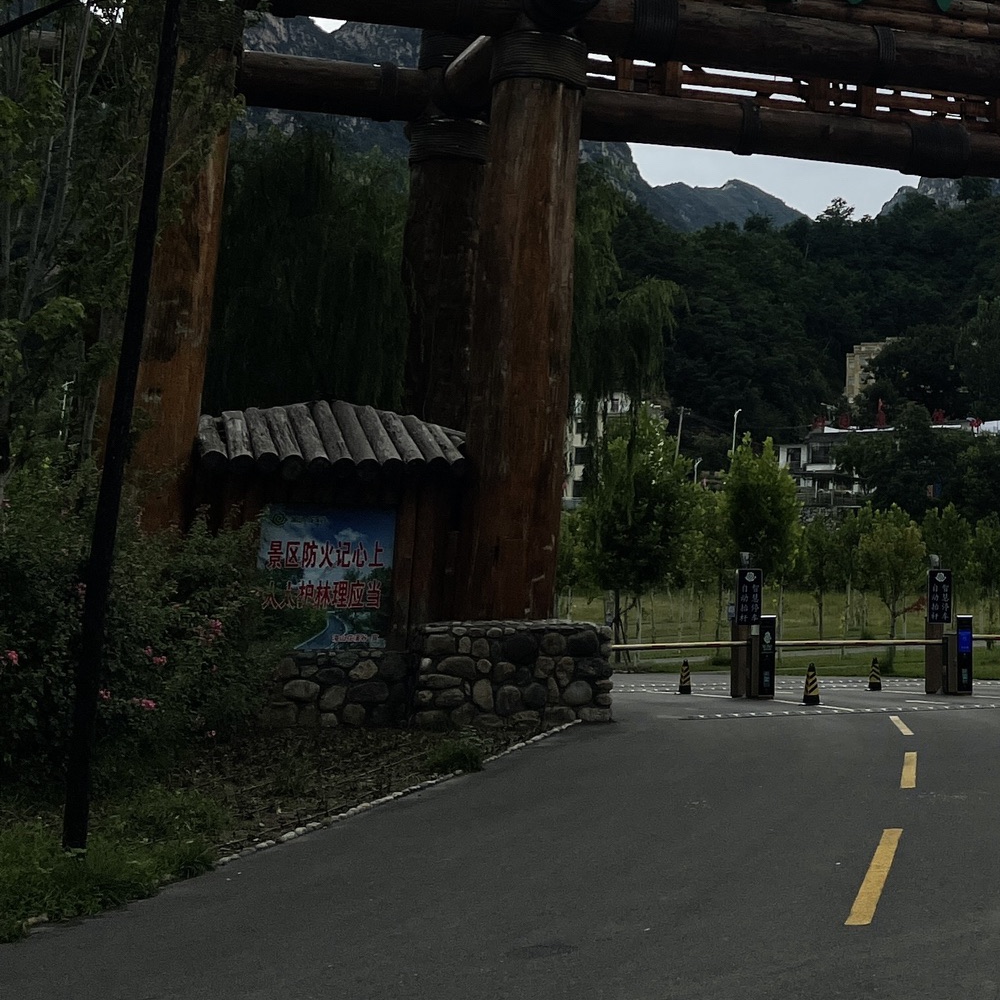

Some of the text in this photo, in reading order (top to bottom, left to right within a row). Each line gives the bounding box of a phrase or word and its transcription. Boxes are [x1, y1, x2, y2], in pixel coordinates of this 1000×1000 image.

[266, 540, 385, 569] 景区防火记心上
[261, 579, 383, 609] 人人护林理应当
